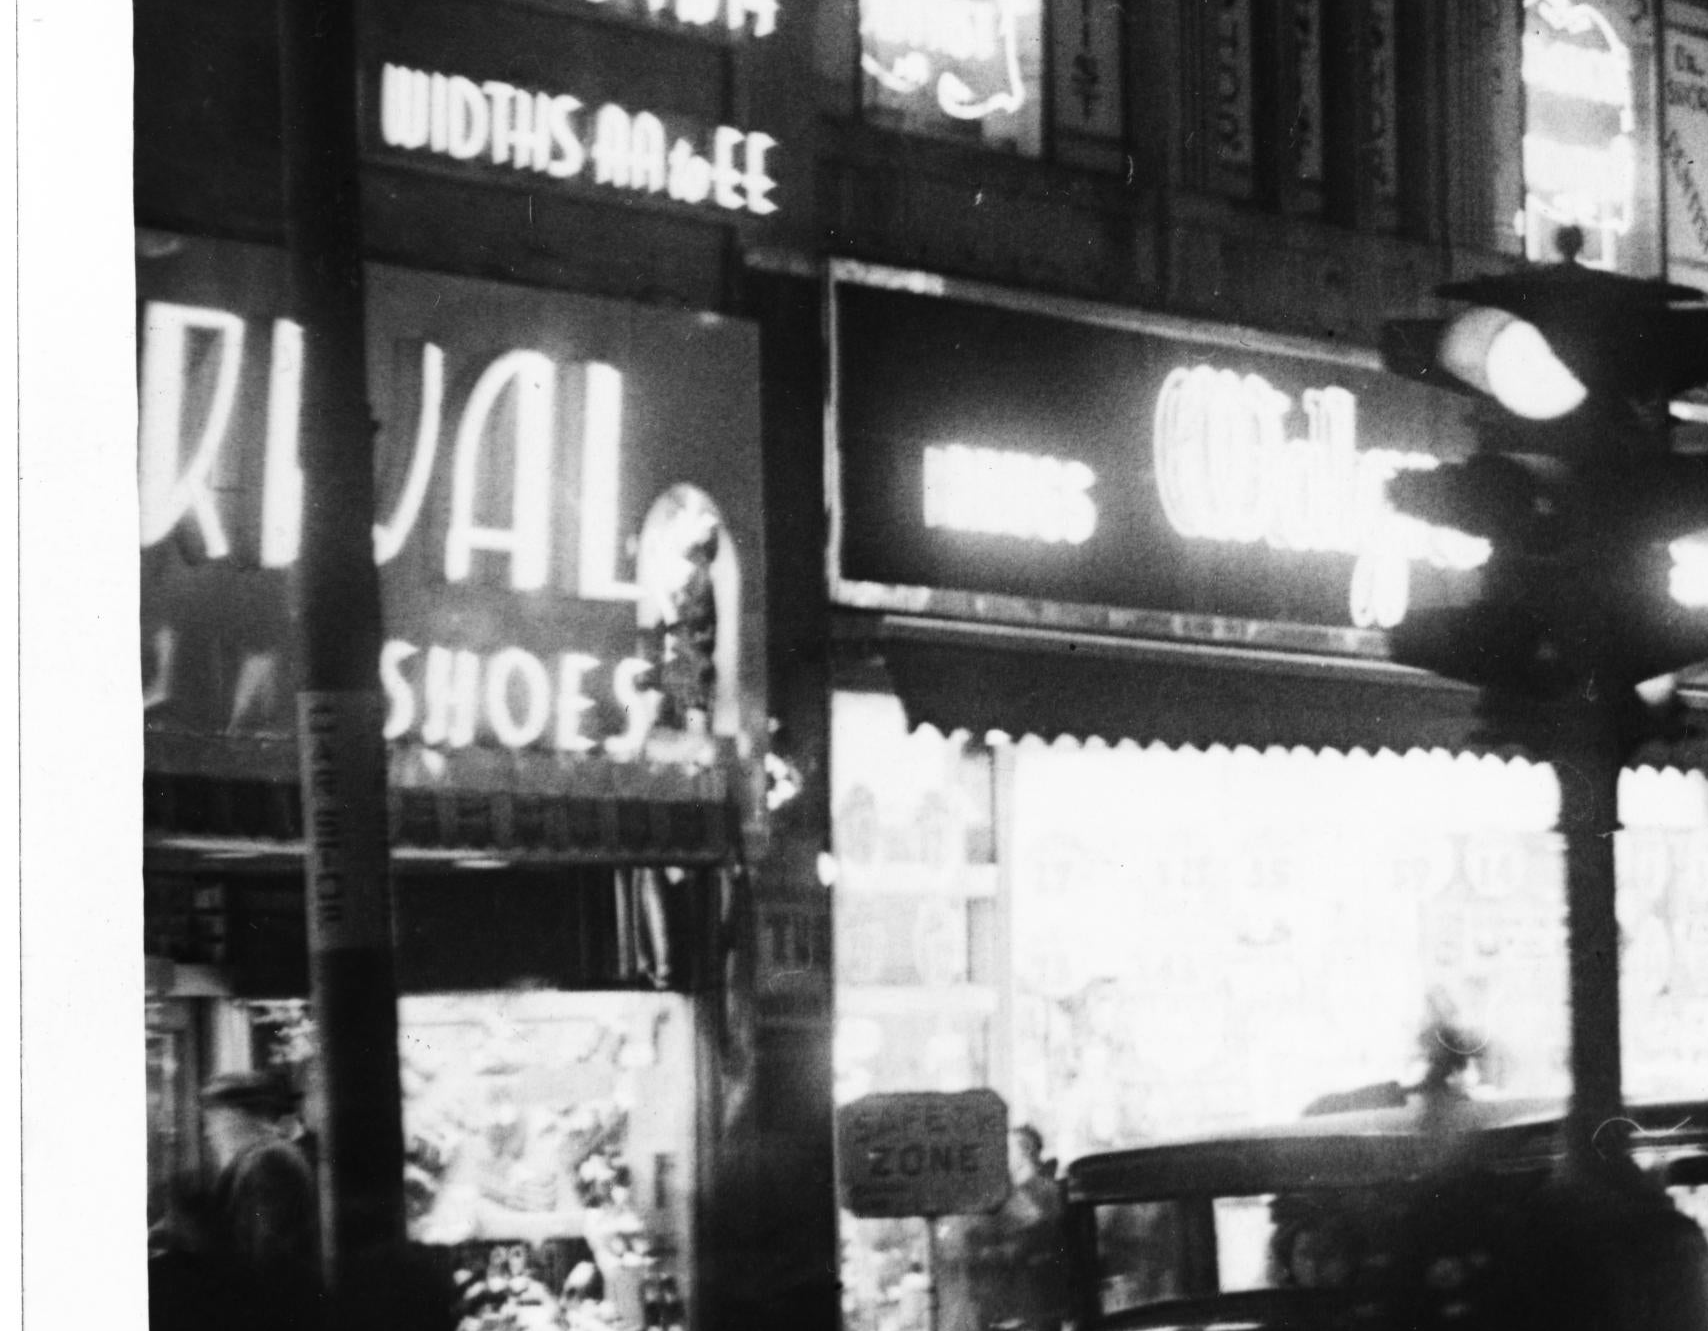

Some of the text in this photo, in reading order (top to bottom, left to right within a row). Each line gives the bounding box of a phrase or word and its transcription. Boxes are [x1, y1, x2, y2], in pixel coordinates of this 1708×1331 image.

[382, 63, 779, 215] WIDTHS AA to EE
[381, 639, 662, 761] SHOES
[854, 1100, 998, 1145] SAFETY
[869, 1142, 982, 1179] ZONE
